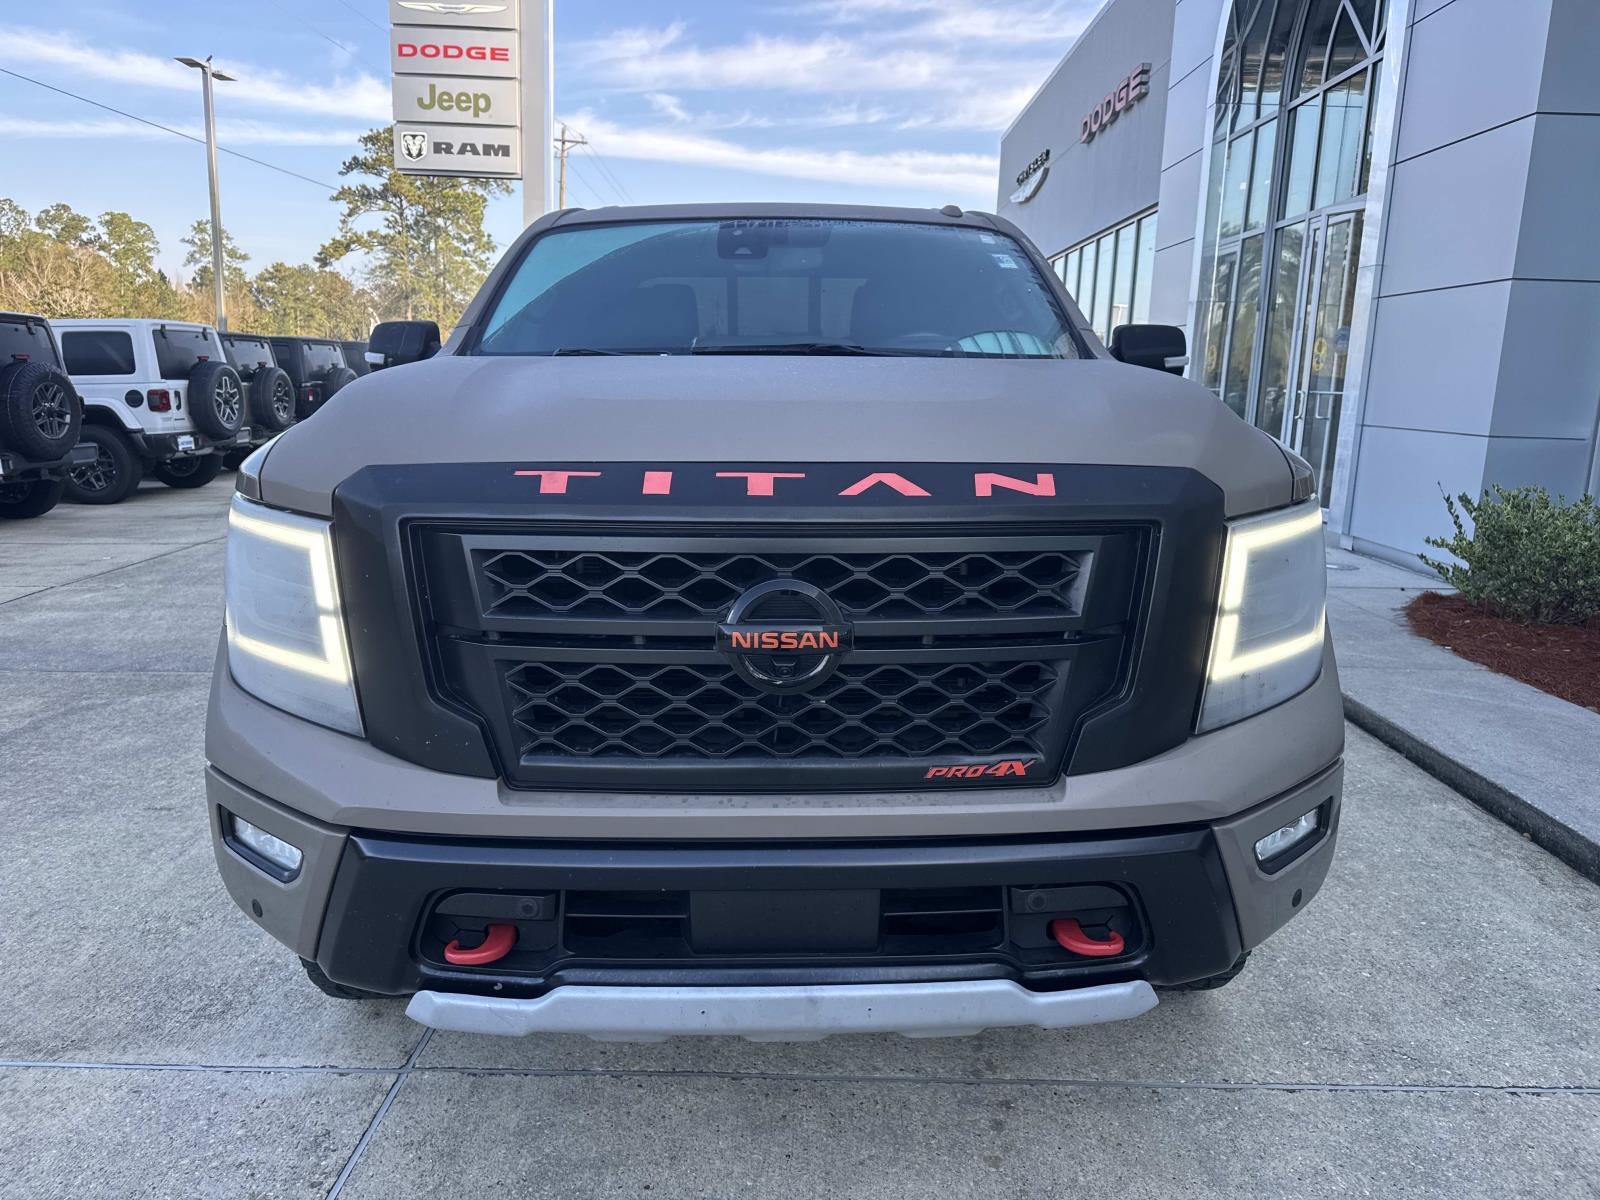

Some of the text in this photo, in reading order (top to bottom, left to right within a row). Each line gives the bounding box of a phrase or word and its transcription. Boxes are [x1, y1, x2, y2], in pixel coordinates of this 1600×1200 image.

[397, 43, 509, 62] DODGE
[416, 83, 492, 118] Jeep
[1080, 62, 1152, 144] DODGE
[432, 141, 511, 158] RAM
[513, 470, 1056, 497] TITAN
[731, 631, 839, 649] NISSAN
